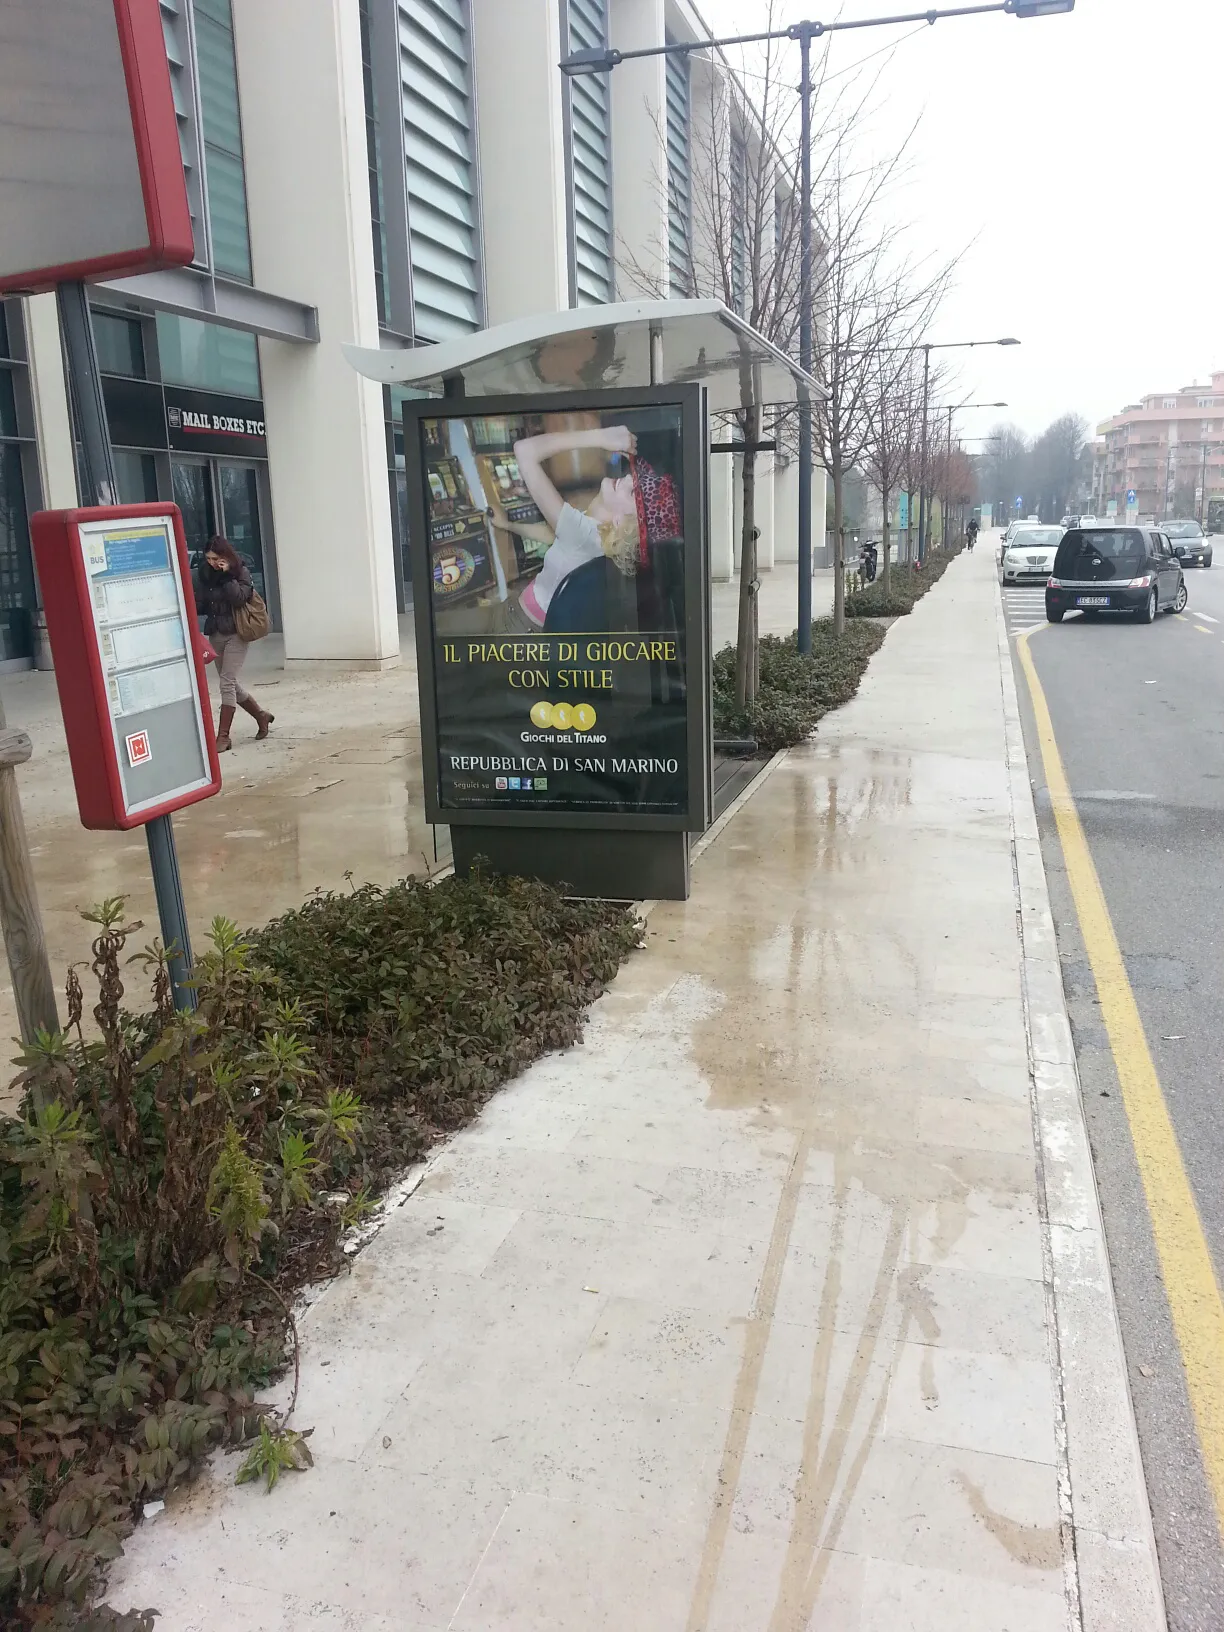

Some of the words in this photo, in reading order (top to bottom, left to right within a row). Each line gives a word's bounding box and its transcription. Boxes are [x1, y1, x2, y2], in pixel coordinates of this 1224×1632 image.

[182, 411, 211, 429] MAIL
[212, 415, 245, 433] BOXES
[90, 556, 104, 564] BUS
[443, 644, 461, 663] IL
[467, 643, 551, 662] PIACERE
[557, 642, 578, 661] DI
[586, 641, 677, 662] GIOCARE
[508, 669, 550, 688] CON
[557, 669, 613, 689] STILE
[520, 731, 555, 743] GIOCHI
[556, 735, 574, 744] DEL
[574, 732, 607, 744] TITANO
[450, 756, 547, 772] REPUBBLICA
[552, 757, 569, 772] DI
[574, 758, 606, 773] SAN
[611, 758, 678, 774] MARINO
[453, 781, 480, 790] Seguici
